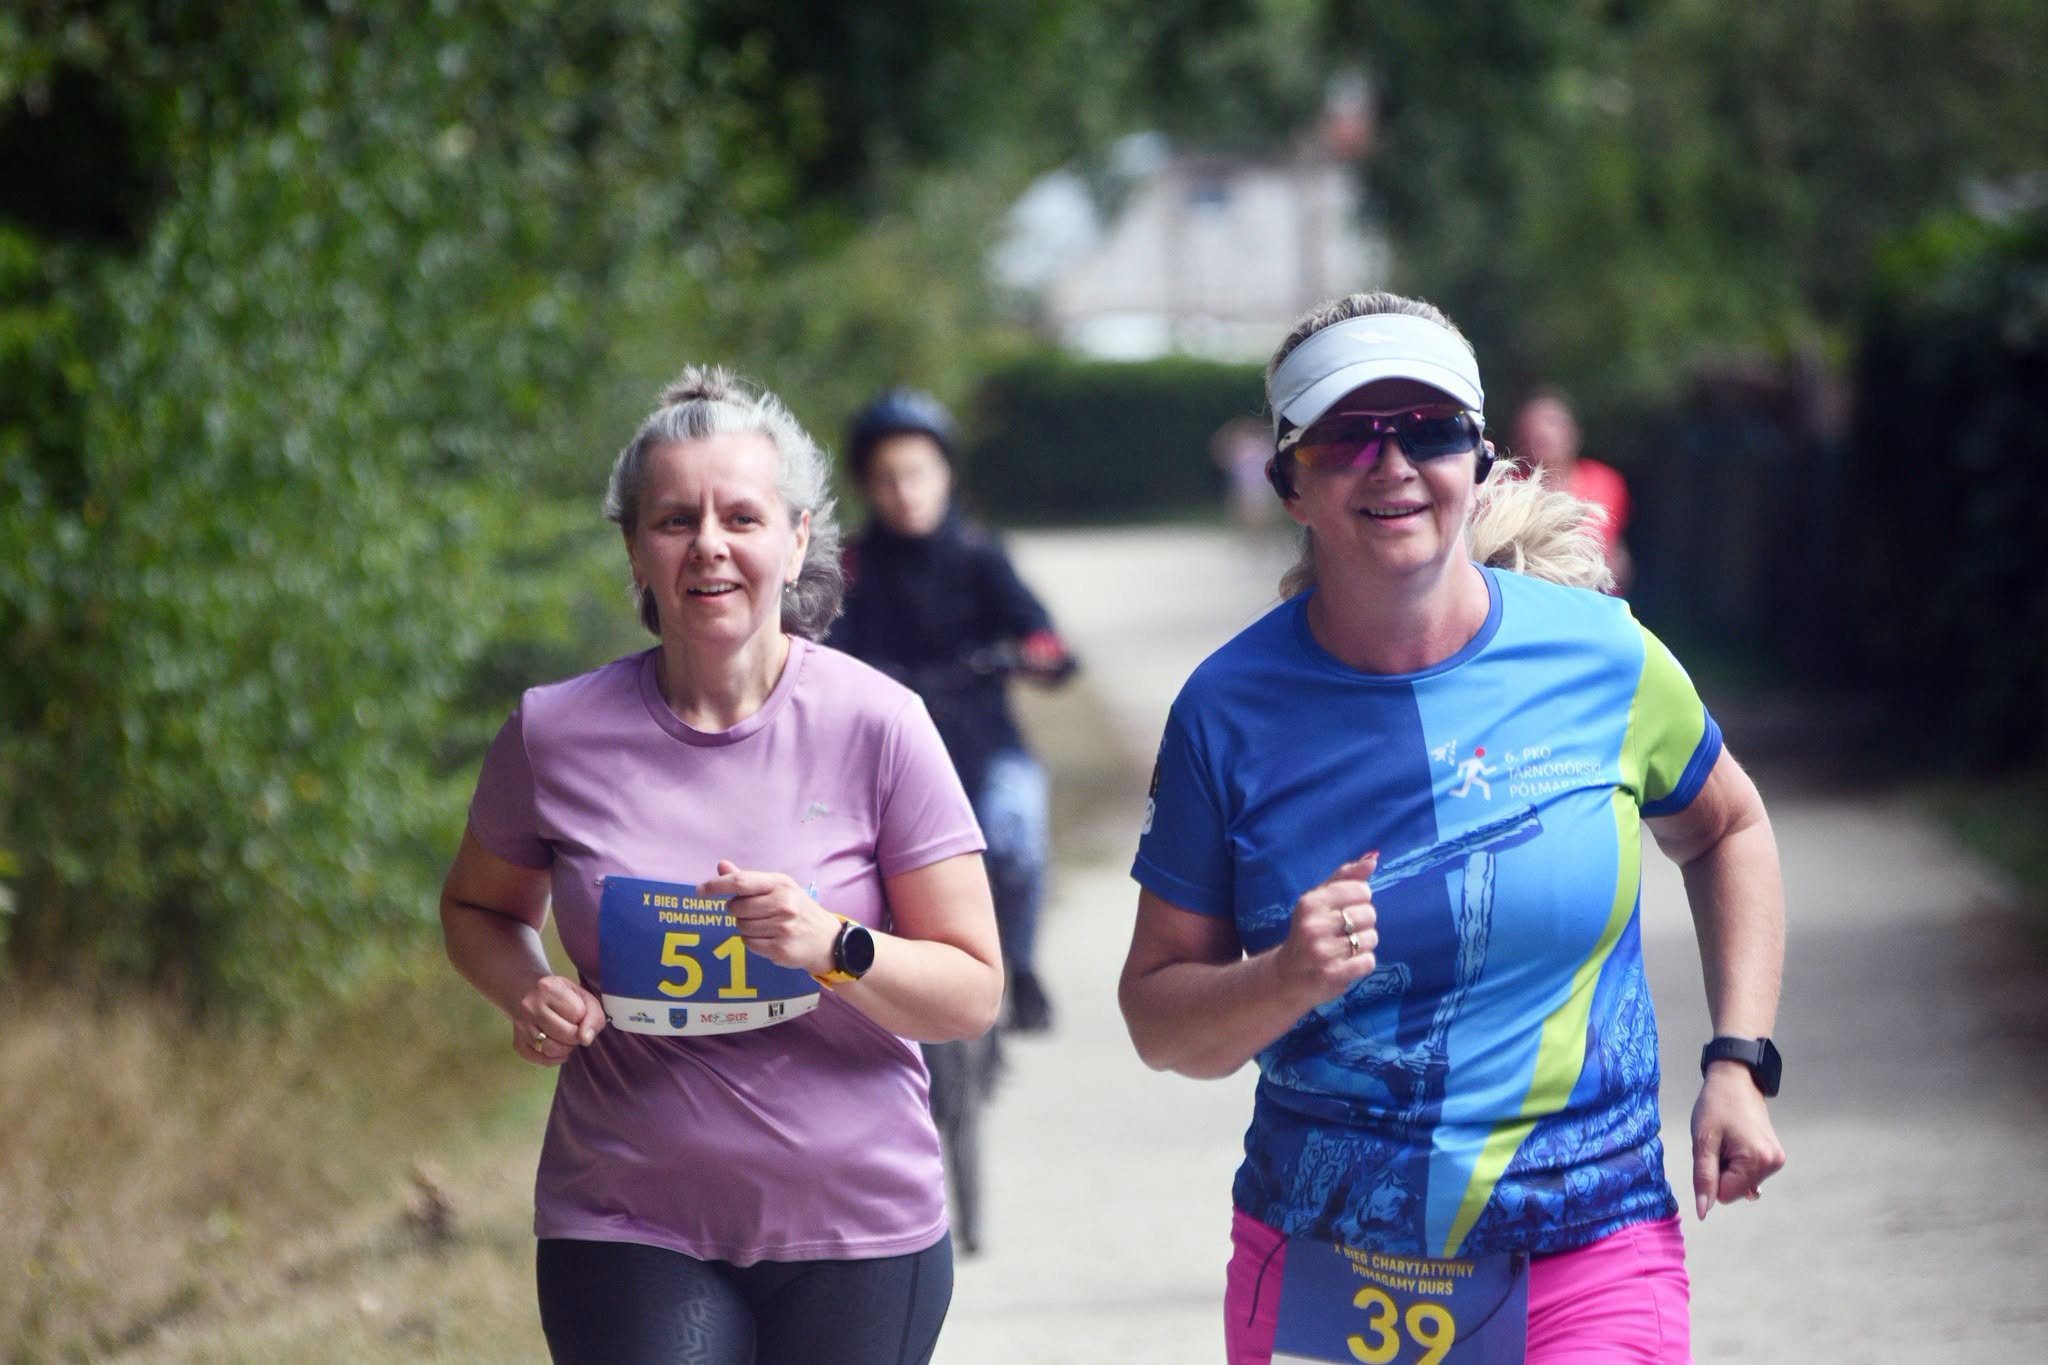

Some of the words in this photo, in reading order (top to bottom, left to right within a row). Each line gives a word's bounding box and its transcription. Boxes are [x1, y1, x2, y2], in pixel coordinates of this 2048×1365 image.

[1523, 745, 1552, 760] PKO
[642, 893, 650, 906] X
[654, 895, 678, 909] BIEG
[682, 897, 727, 912] CHARYT
[658, 911, 723, 927] POMAGAMY
[657, 931, 758, 999] 51
[1334, 1243, 1341, 1255] X
[1343, 1246, 1368, 1265] BIEG
[1372, 1254, 1474, 1278] CHARYTATYWNY
[1352, 1263, 1416, 1292] POMAGAMY
[1347, 1286, 1456, 1365] 39
